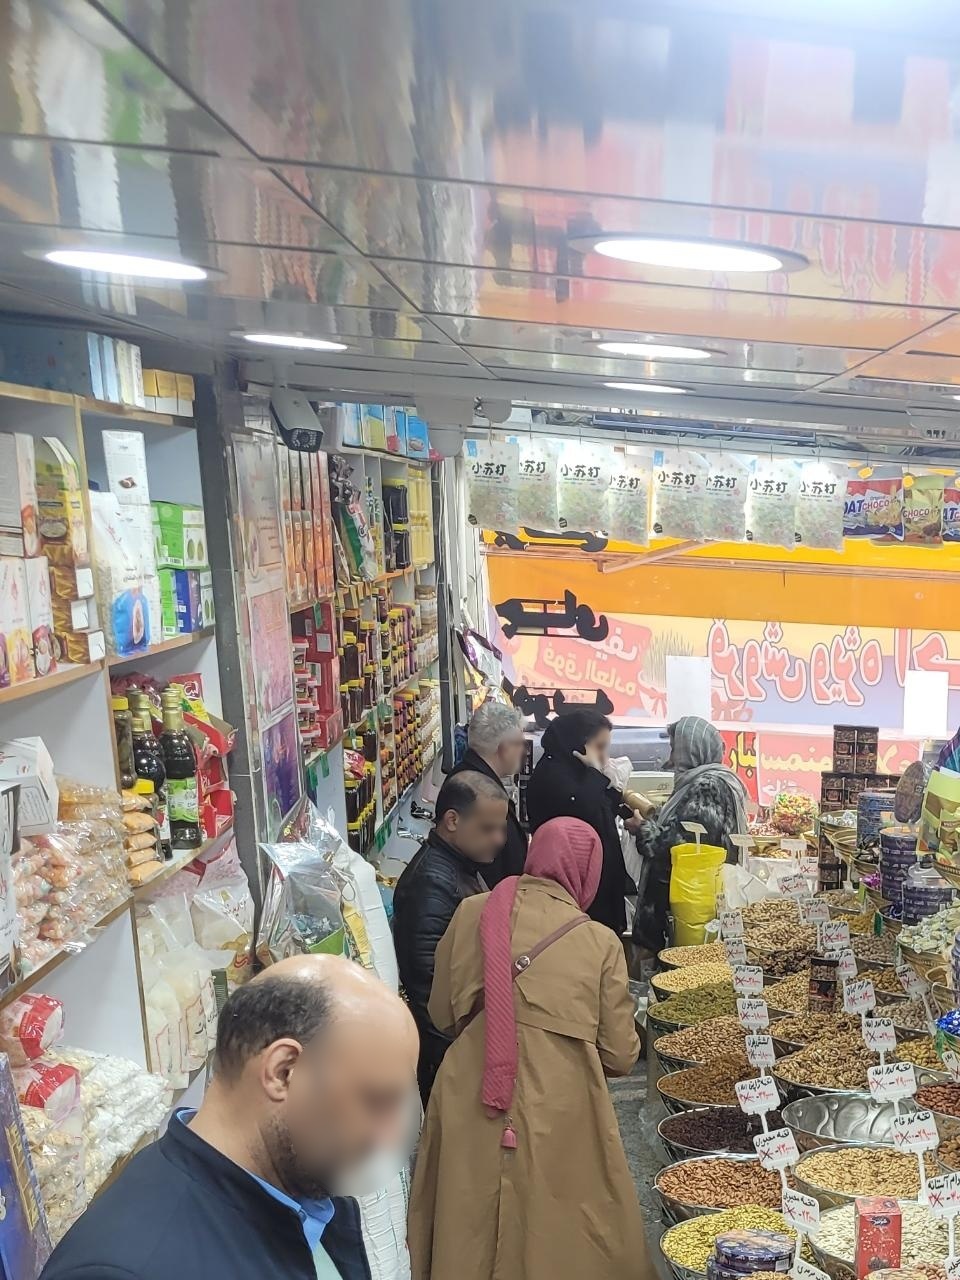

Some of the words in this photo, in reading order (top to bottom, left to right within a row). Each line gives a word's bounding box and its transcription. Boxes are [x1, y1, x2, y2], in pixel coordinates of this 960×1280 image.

[471, 461, 507, 477] 小苏打
[560, 463, 600, 478] 小苏打
[657, 471, 697, 486] 小苏打
[750, 478, 788, 493] 小苏打
[800, 481, 837, 495] 小苏打
